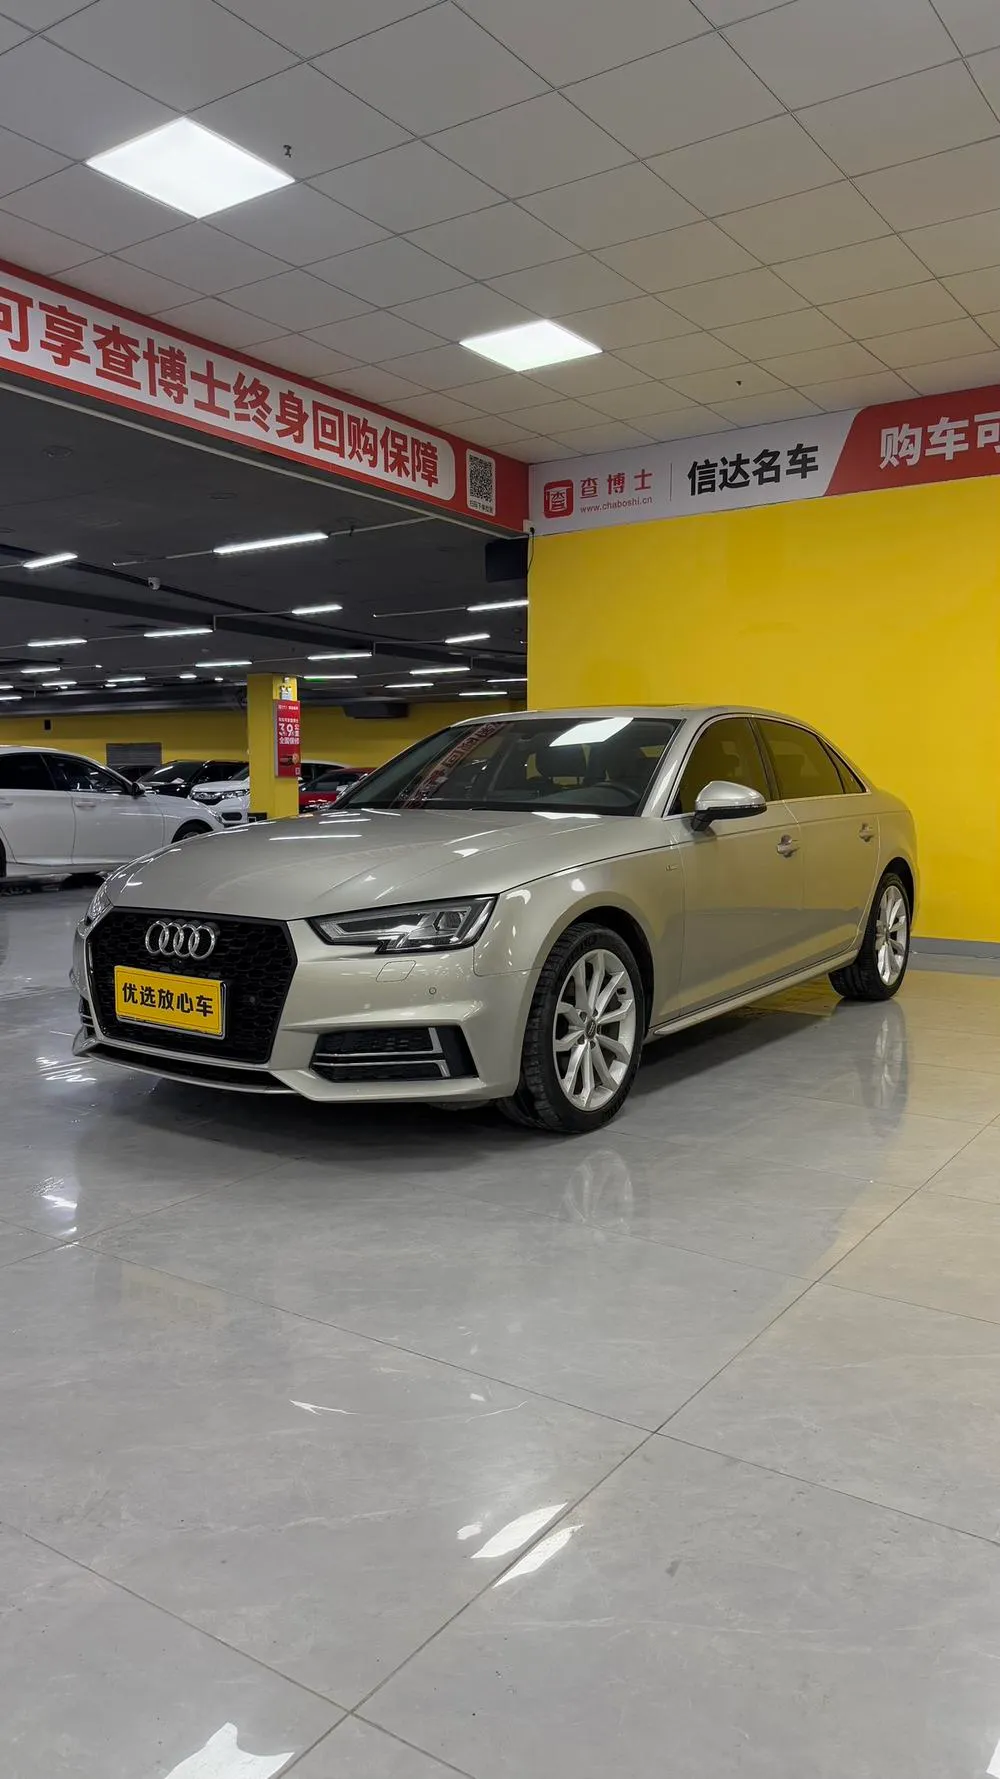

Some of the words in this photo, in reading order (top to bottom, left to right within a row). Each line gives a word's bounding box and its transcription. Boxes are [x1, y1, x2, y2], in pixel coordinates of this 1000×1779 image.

[0, 287, 439, 487] 可享查博士终身回购保障
[580, 469, 653, 499] 查博士
[687, 442, 819, 496] 信达名车
[580, 496, 653, 513] www.chaboshi.cn
[122, 982, 214, 1017] 优选放心车
